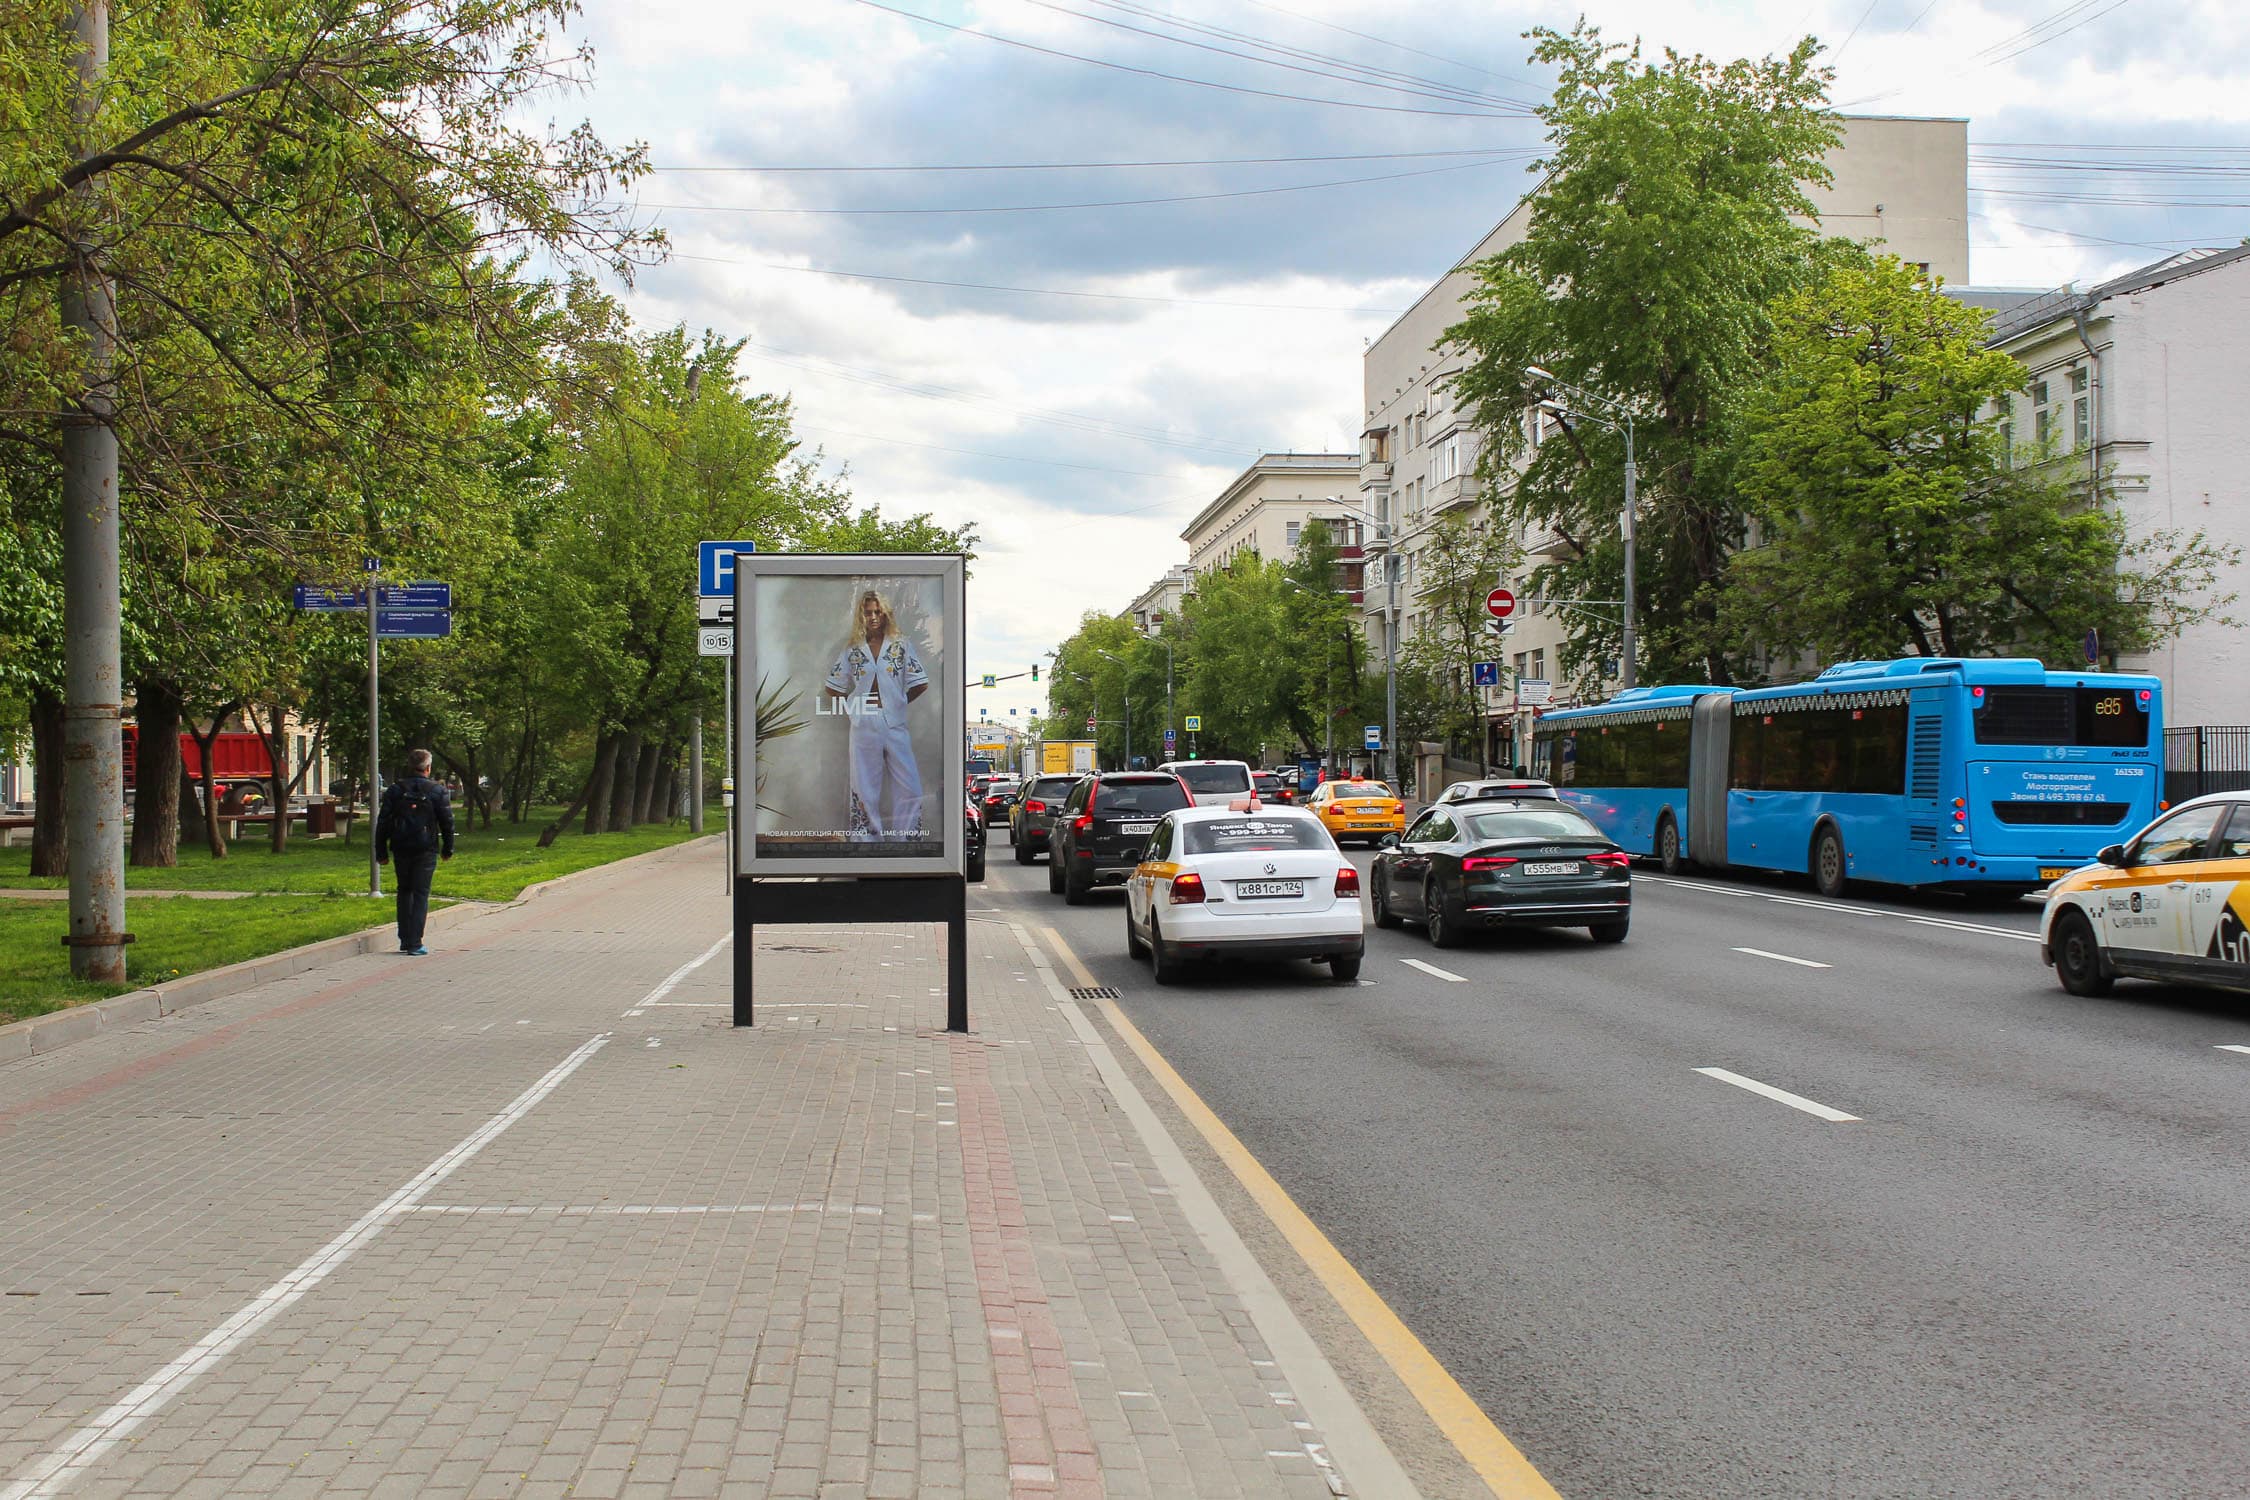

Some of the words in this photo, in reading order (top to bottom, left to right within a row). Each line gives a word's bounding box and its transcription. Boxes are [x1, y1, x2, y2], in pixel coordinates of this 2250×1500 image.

[714, 549, 735, 589] P
[705, 637, 715, 647] 10
[717, 636, 729, 648] 15
[2095, 697, 2121, 715] e85
[2022, 772, 2047, 780] Стань
[2048, 773, 2096, 781] водителем
[2114, 768, 2144, 776] 161538
[2026, 783, 2091, 791] Мосгортранса!
[2010, 792, 2037, 800] Звони
[2046, 793, 2063, 801] 495
[2065, 793, 2082, 801] 398
[1229, 828, 1285, 836] 999-99-99
[1284, 882, 1301, 891] 124
